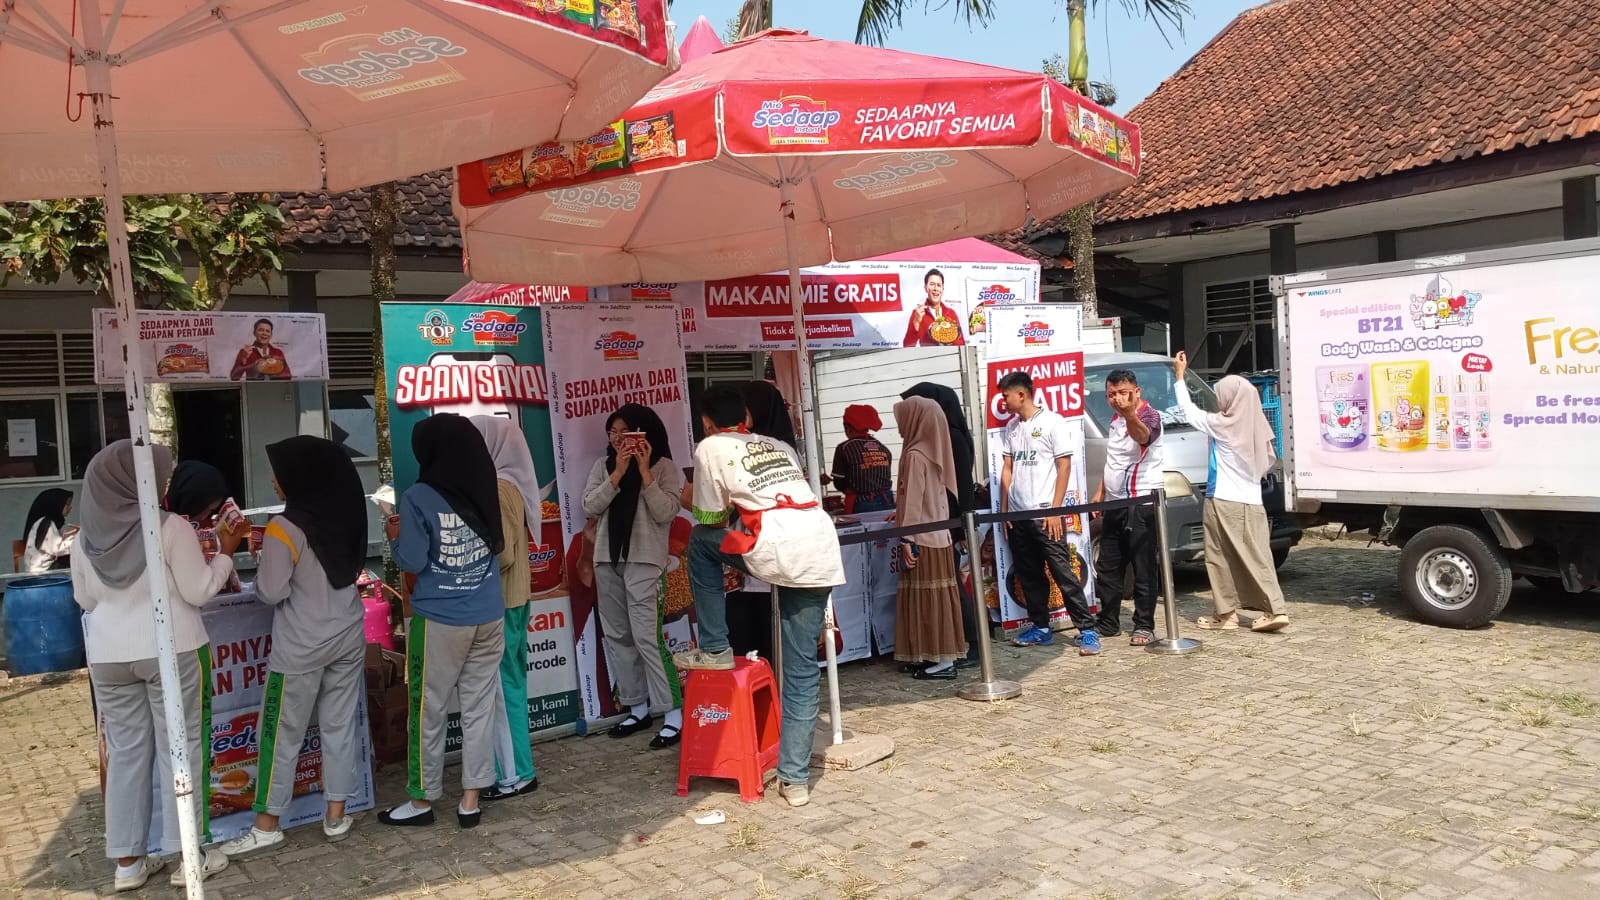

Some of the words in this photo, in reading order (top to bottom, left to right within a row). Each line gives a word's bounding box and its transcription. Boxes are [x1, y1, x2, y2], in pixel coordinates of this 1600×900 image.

[762, 101, 782, 110] Mie
[854, 101, 956, 124] SEDAAPNYA
[753, 109, 840, 129] Sedaap
[860, 118, 946, 143] FAVORIT
[949, 113, 1016, 135] SEMUA
[709, 285, 790, 305] MAKAN
[801, 284, 828, 303] MIE
[834, 283, 898, 303] GRATIS
[978, 291, 1015, 300] Sedaap
[1308, 288, 1342, 296] WINGSCARE
[1320, 306, 1359, 318] Special
[1361, 303, 1401, 313] edition
[141, 320, 190, 330] SEDAAPNYA
[194, 318, 213, 327] DARI
[417, 325, 455, 338] TOP
[462, 319, 527, 335] Sedaap
[764, 327, 787, 335] Tidak
[1358, 316, 1403, 333] BT21
[139, 330, 173, 340] SUAPAN
[177, 328, 215, 338] PERTAMA
[1017, 327, 1055, 338] Sedaap
[594, 340, 644, 350] Sedaap
[1321, 342, 1359, 359] Body
[1359, 339, 1401, 354] Wash
[1402, 337, 1416, 351] &
[1417, 335, 1483, 352] Cologne
[1524, 317, 1600, 365] Fre
[1467, 362, 1485, 370] Look
[1468, 355, 1488, 364] NEW
[1054, 360, 1077, 378] MIE
[1540, 365, 1551, 375] &
[396, 365, 471, 405] SCAN
[477, 365, 548, 402] SAYA!
[565, 373, 643, 399] SEDAAPNYA
[648, 368, 676, 387] DARI
[565, 395, 619, 419] SUAPAN
[625, 386, 681, 406] PERTAMA
[991, 382, 1082, 421] GATIS
[1536, 395, 1558, 407] Be
[1503, 412, 1567, 428] Spread
[746, 441, 774, 455] Soto
[741, 451, 787, 472] Madura
[211, 634, 273, 670] PNYA
[542, 695, 569, 710] kami
[296, 769, 316, 781] ENG
